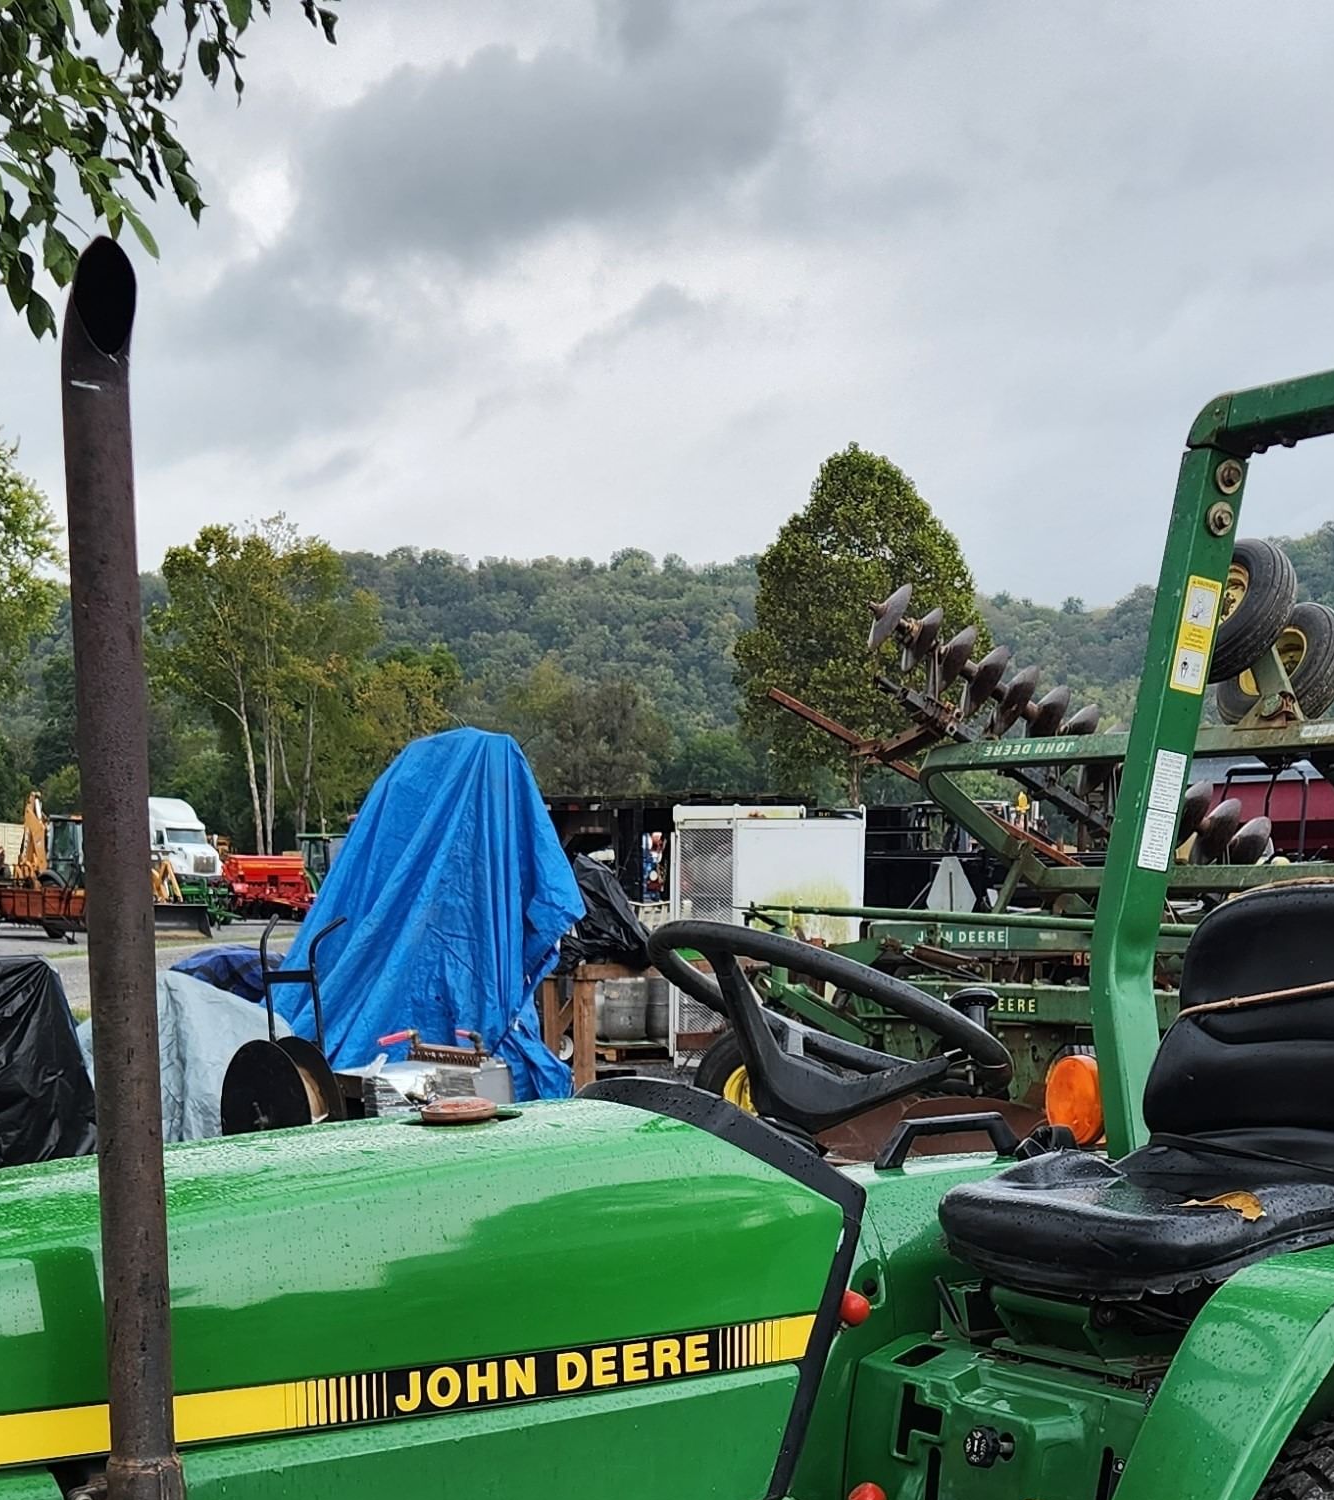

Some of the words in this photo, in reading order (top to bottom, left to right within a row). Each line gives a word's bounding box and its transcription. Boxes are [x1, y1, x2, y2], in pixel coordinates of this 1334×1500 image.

[983, 743, 1031, 757] DEERE
[1034, 741, 1074, 753] JOHN
[917, 931, 953, 943] JN
[958, 931, 1005, 943] DEERE
[395, 1356, 537, 1413] JOHN
[556, 1333, 711, 1392] DEERE
